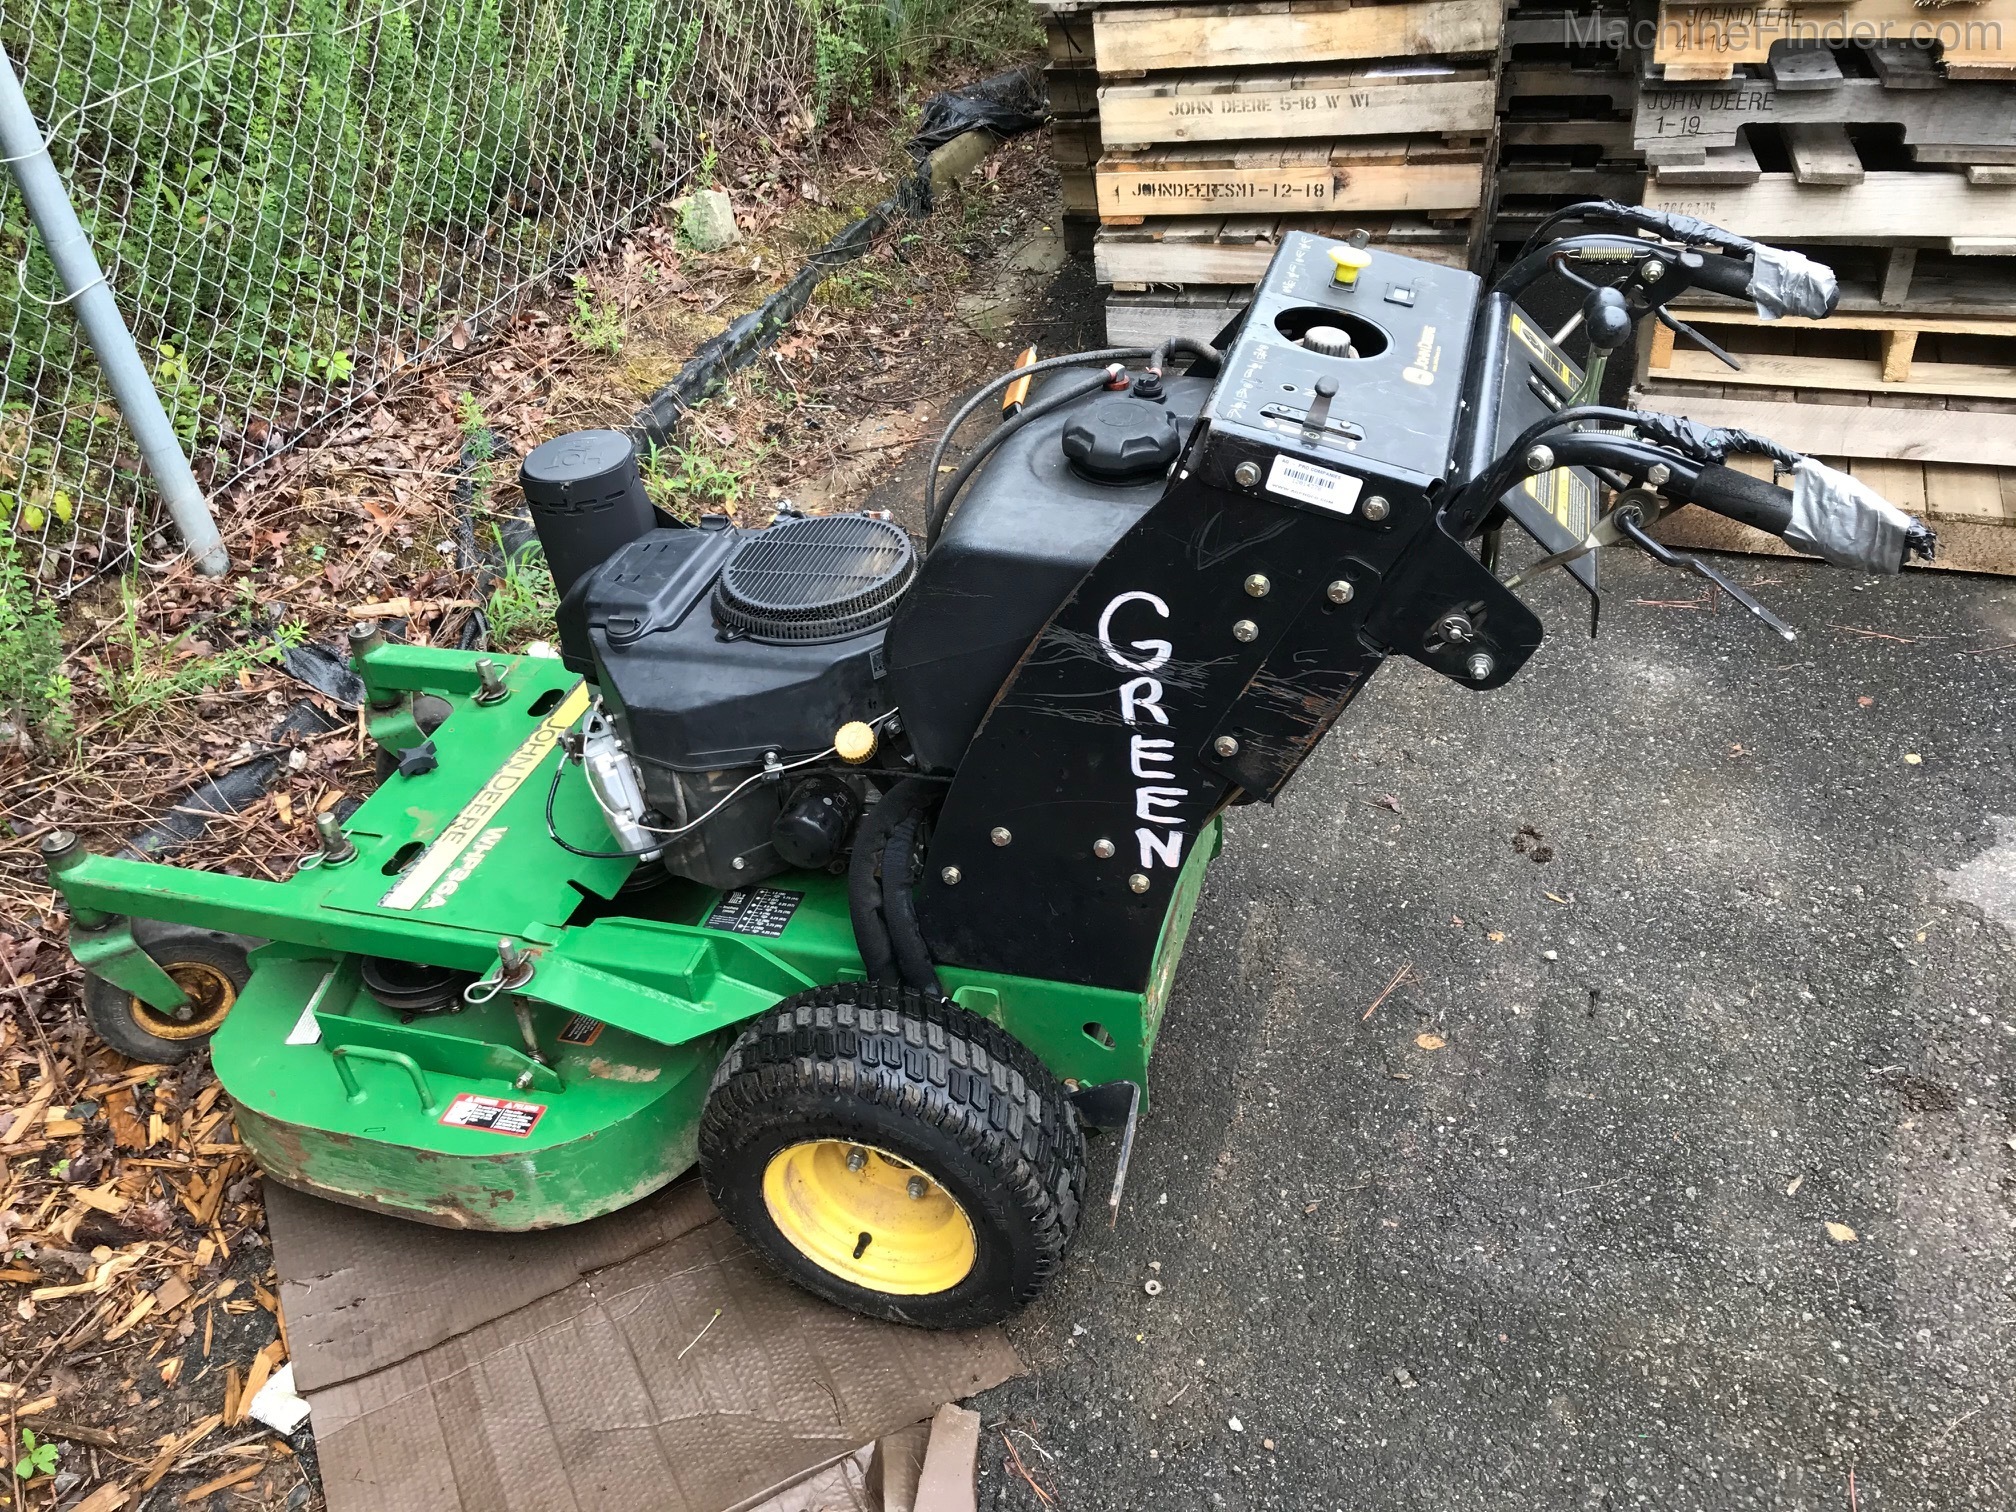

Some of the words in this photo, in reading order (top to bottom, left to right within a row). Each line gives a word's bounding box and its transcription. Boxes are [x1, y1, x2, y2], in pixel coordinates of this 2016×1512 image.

[1686, 7, 1805, 28] JOHNDEERE
[1168, 100, 1213, 116] JOHN
[1222, 98, 1272, 113] DEERE
[1280, 96, 1317, 111] 5-18
[1326, 95, 1340, 109] W
[1350, 94, 1370, 108] WI
[1647, 91, 1703, 110] JOHN
[1709, 91, 1775, 111] DEERE
[1656, 115, 1701, 134] 1-19
[1098, 590, 1188, 869] GREEN
[508, 717, 565, 771] JOHN
[441, 775, 521, 845] DEERE
